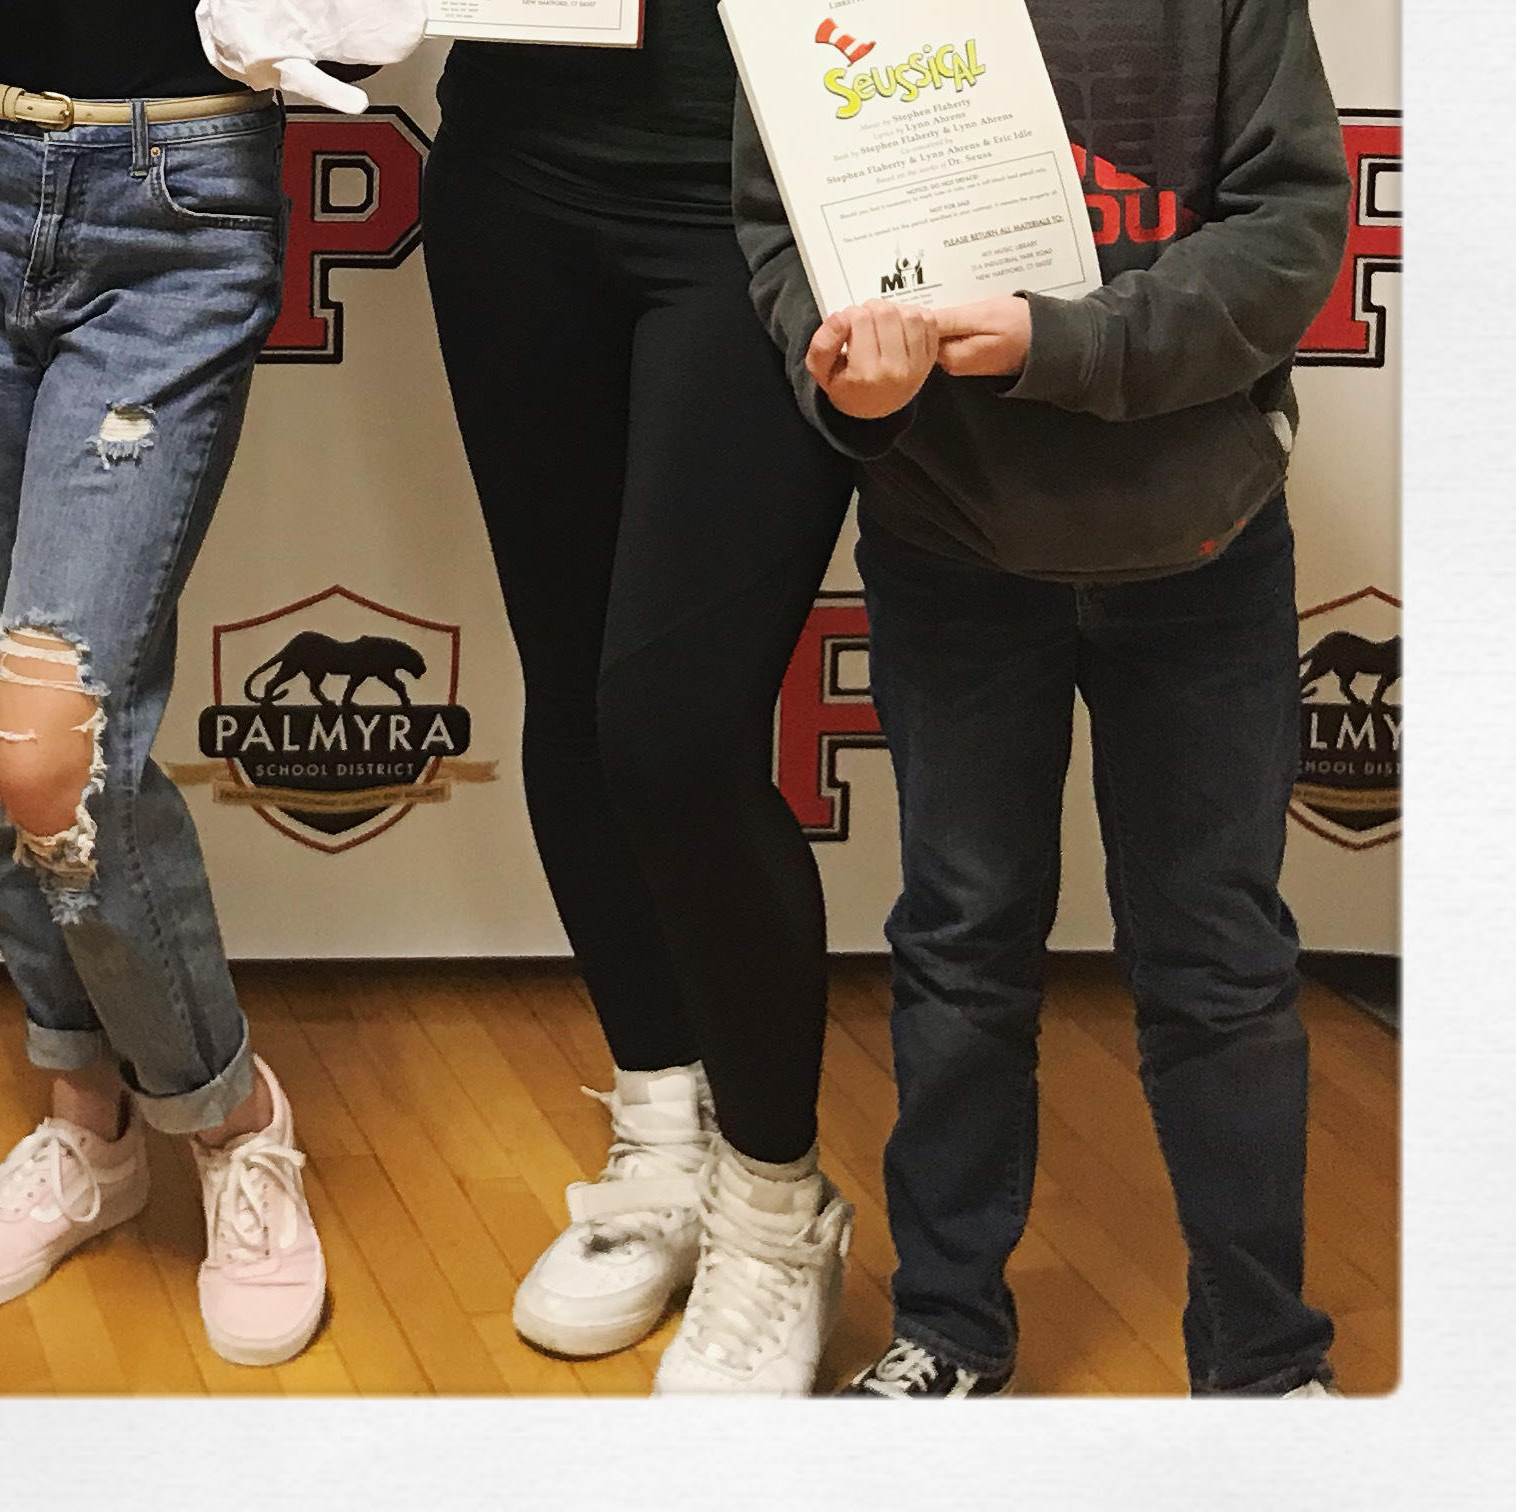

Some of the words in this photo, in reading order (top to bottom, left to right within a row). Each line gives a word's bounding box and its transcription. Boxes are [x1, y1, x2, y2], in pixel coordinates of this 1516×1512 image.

[892, 108, 931, 123] Stephen
[932, 98, 970, 113] Flaherty
[826, 169, 865, 185] Stephen
[866, 158, 906, 175] Flaherty
[919, 150, 944, 162] Lynn
[946, 141, 980, 154] Ahrens
[992, 133, 1011, 144] Eric
[1013, 128, 1032, 139] Idle
[964, 151, 992, 162] Seuss
[255, 105, 432, 364] P
[942, 235, 969, 247] PLEASE
[969, 228, 999, 242] RETURN
[998, 226, 1012, 235] ALL
[1012, 217, 1052, 232] MATERIALS
[215, 713, 455, 753] PALMYRA
[256, 763, 328, 776] SCHOOL
[337, 762, 415, 776] DISTRICT
[1300, 760, 1355, 775] HOOL
